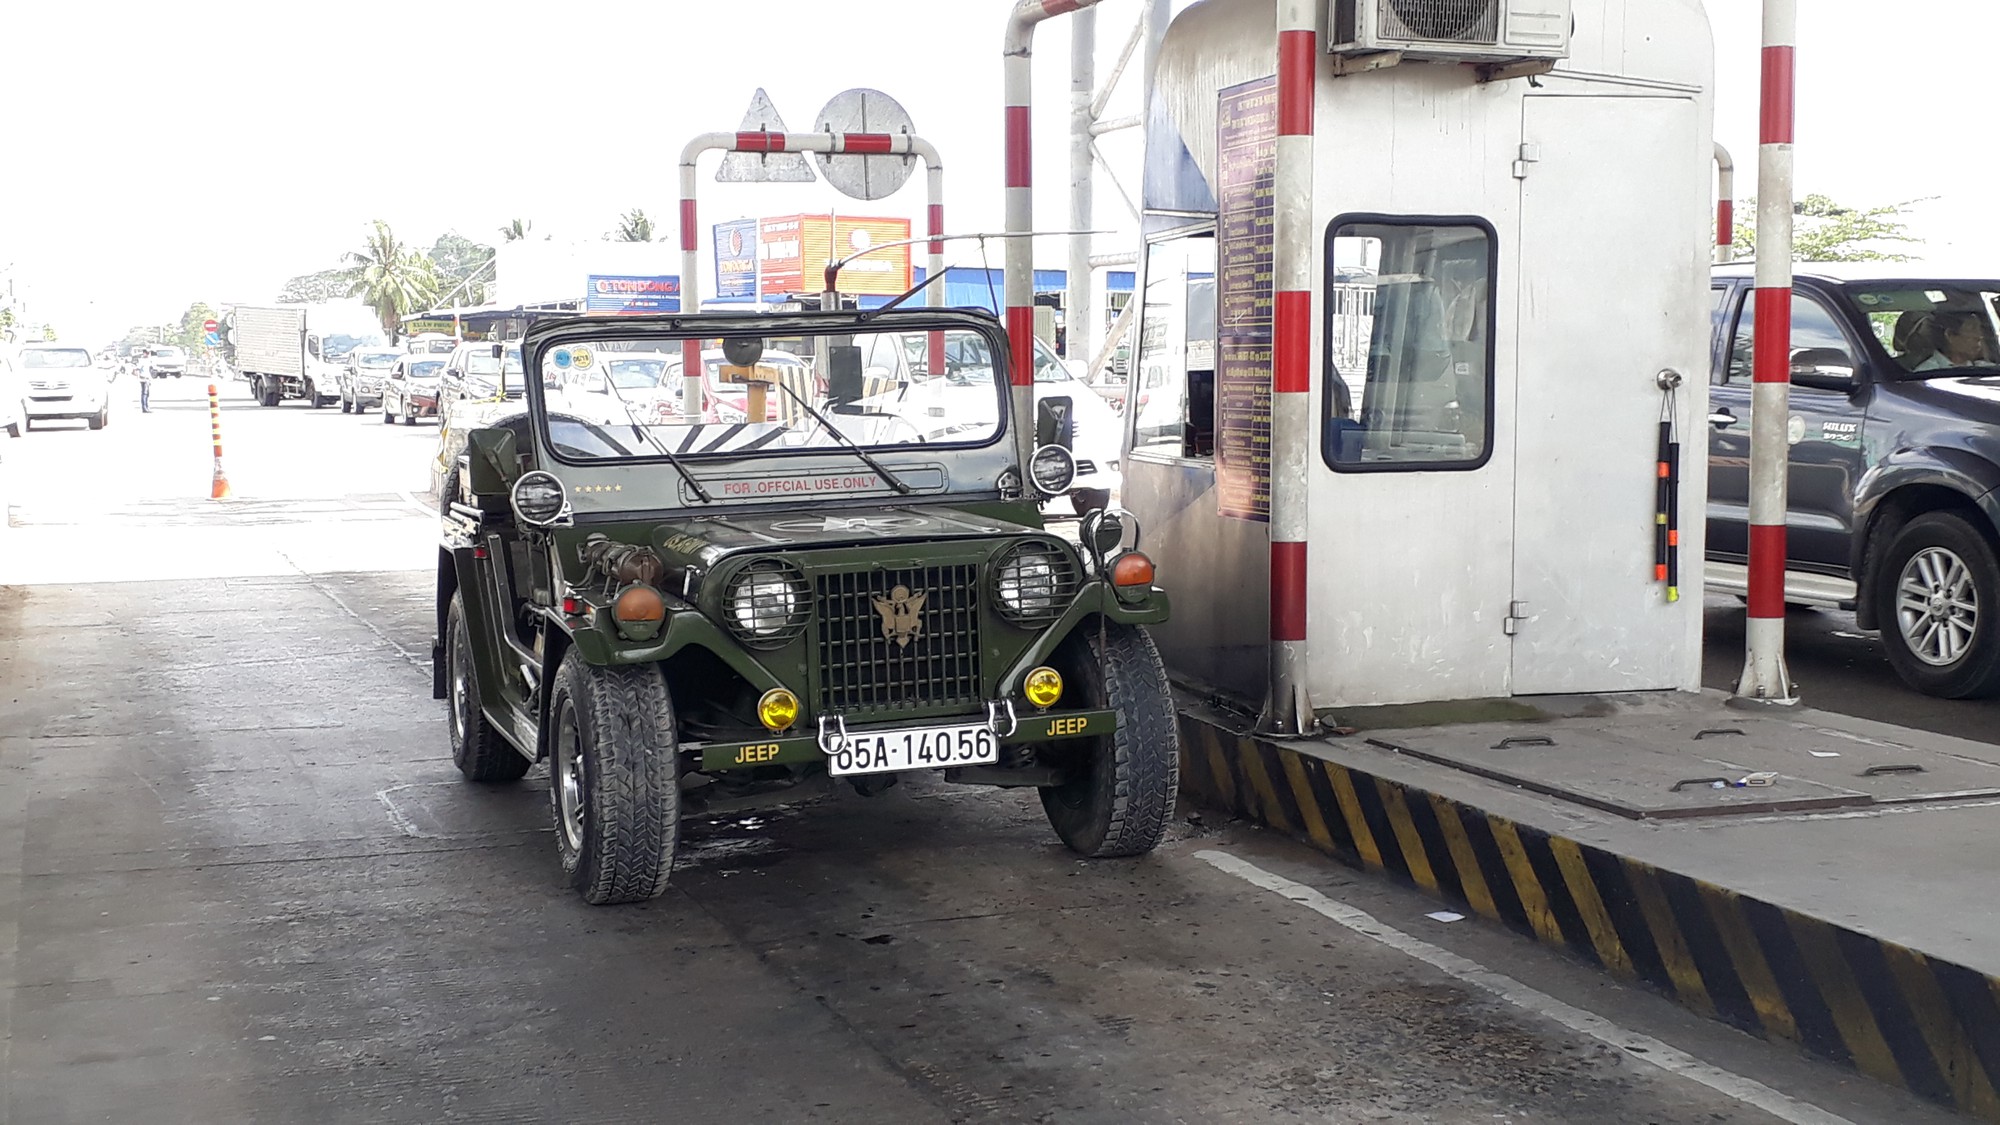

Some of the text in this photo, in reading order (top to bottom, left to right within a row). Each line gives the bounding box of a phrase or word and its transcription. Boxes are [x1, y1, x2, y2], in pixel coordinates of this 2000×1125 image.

[1823, 422, 1857, 432] HILUX
[724, 483, 751, 494] FOR
[1046, 717, 1088, 736] JEEP
[735, 744, 780, 763] JEEP
[837, 727, 992, 769] 65A-140.56
